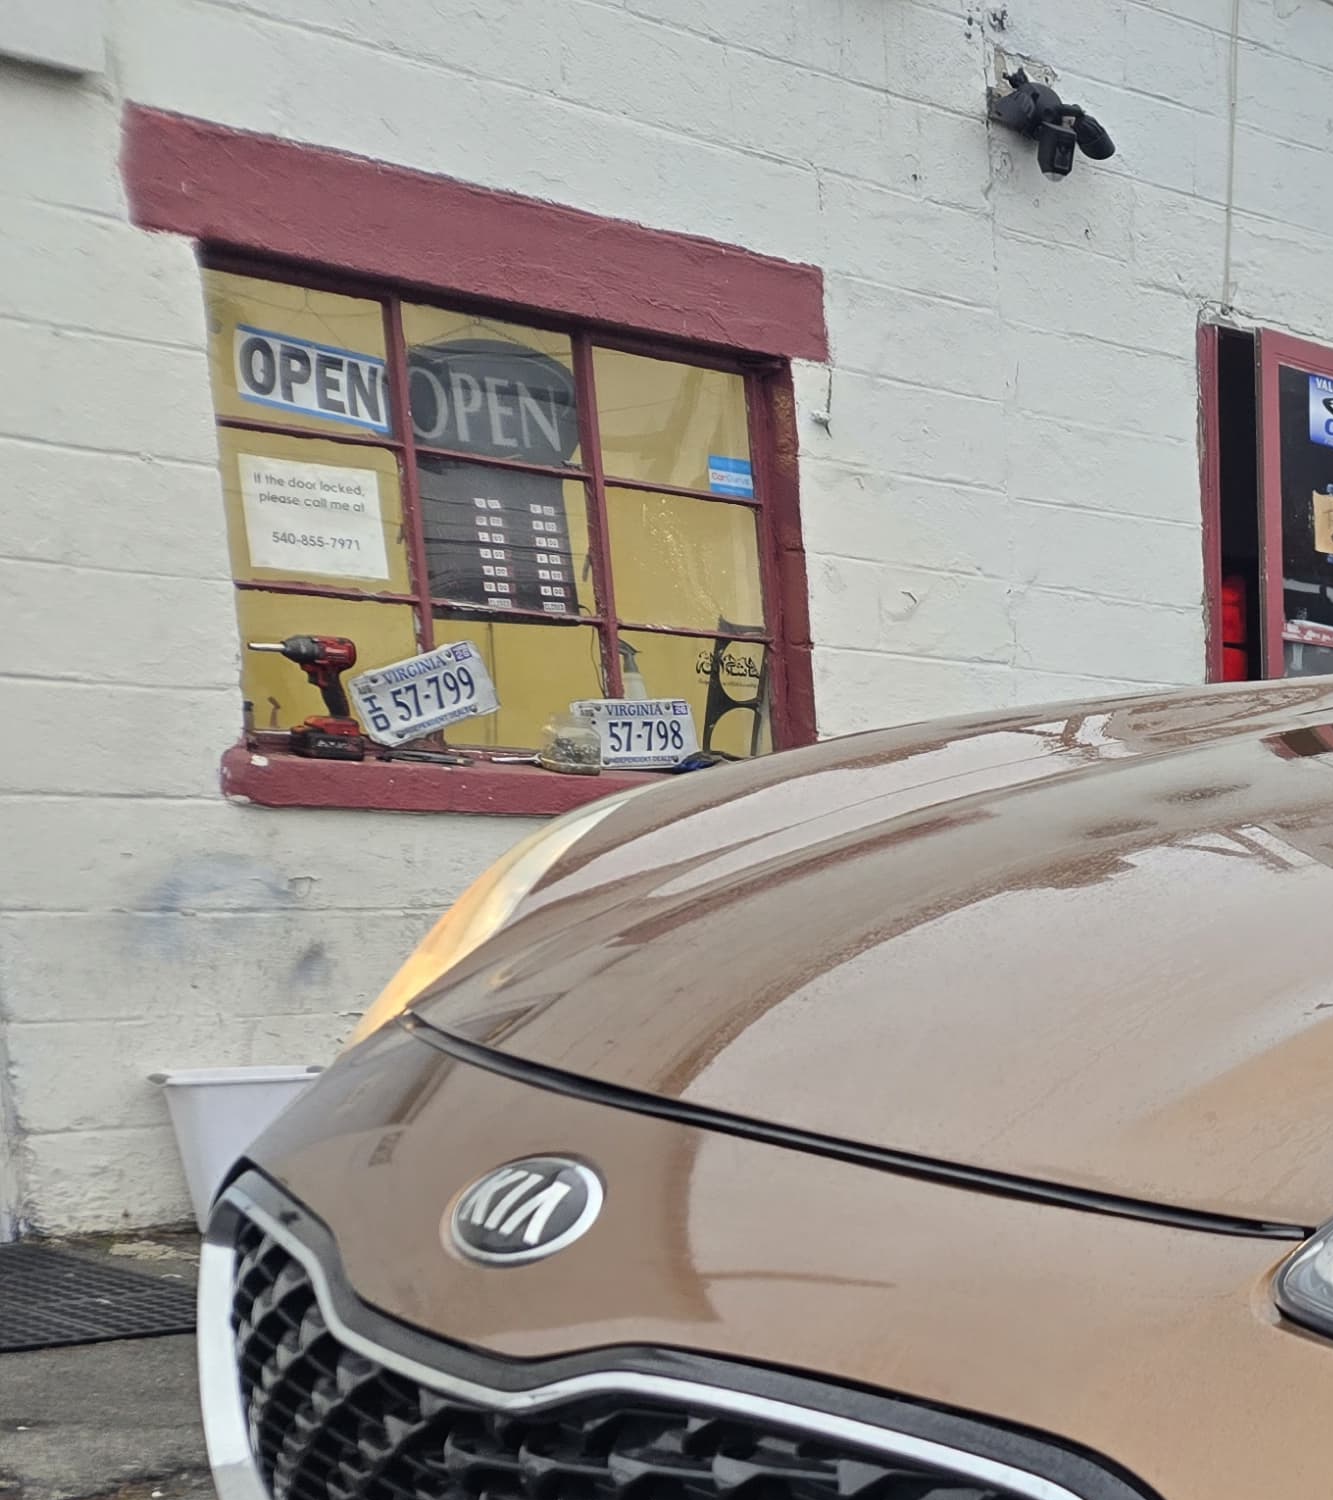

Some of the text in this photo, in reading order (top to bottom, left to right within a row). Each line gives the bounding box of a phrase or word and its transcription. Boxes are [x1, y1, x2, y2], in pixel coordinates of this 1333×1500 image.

[239, 337, 382, 423] OPEN
[409, 366, 562, 452] OPEN
[265, 473, 286, 487] the
[288, 477, 317, 491] door
[258, 491, 366, 513] please call me at
[271, 531, 361, 551] 540-855-7971
[382, 654, 447, 685] VIRGINIA
[390, 666, 475, 722] 57-799
[605, 704, 664, 717] VIRGINIA
[608, 719, 684, 752] 57-798
[459, 1168, 572, 1246] KIA
